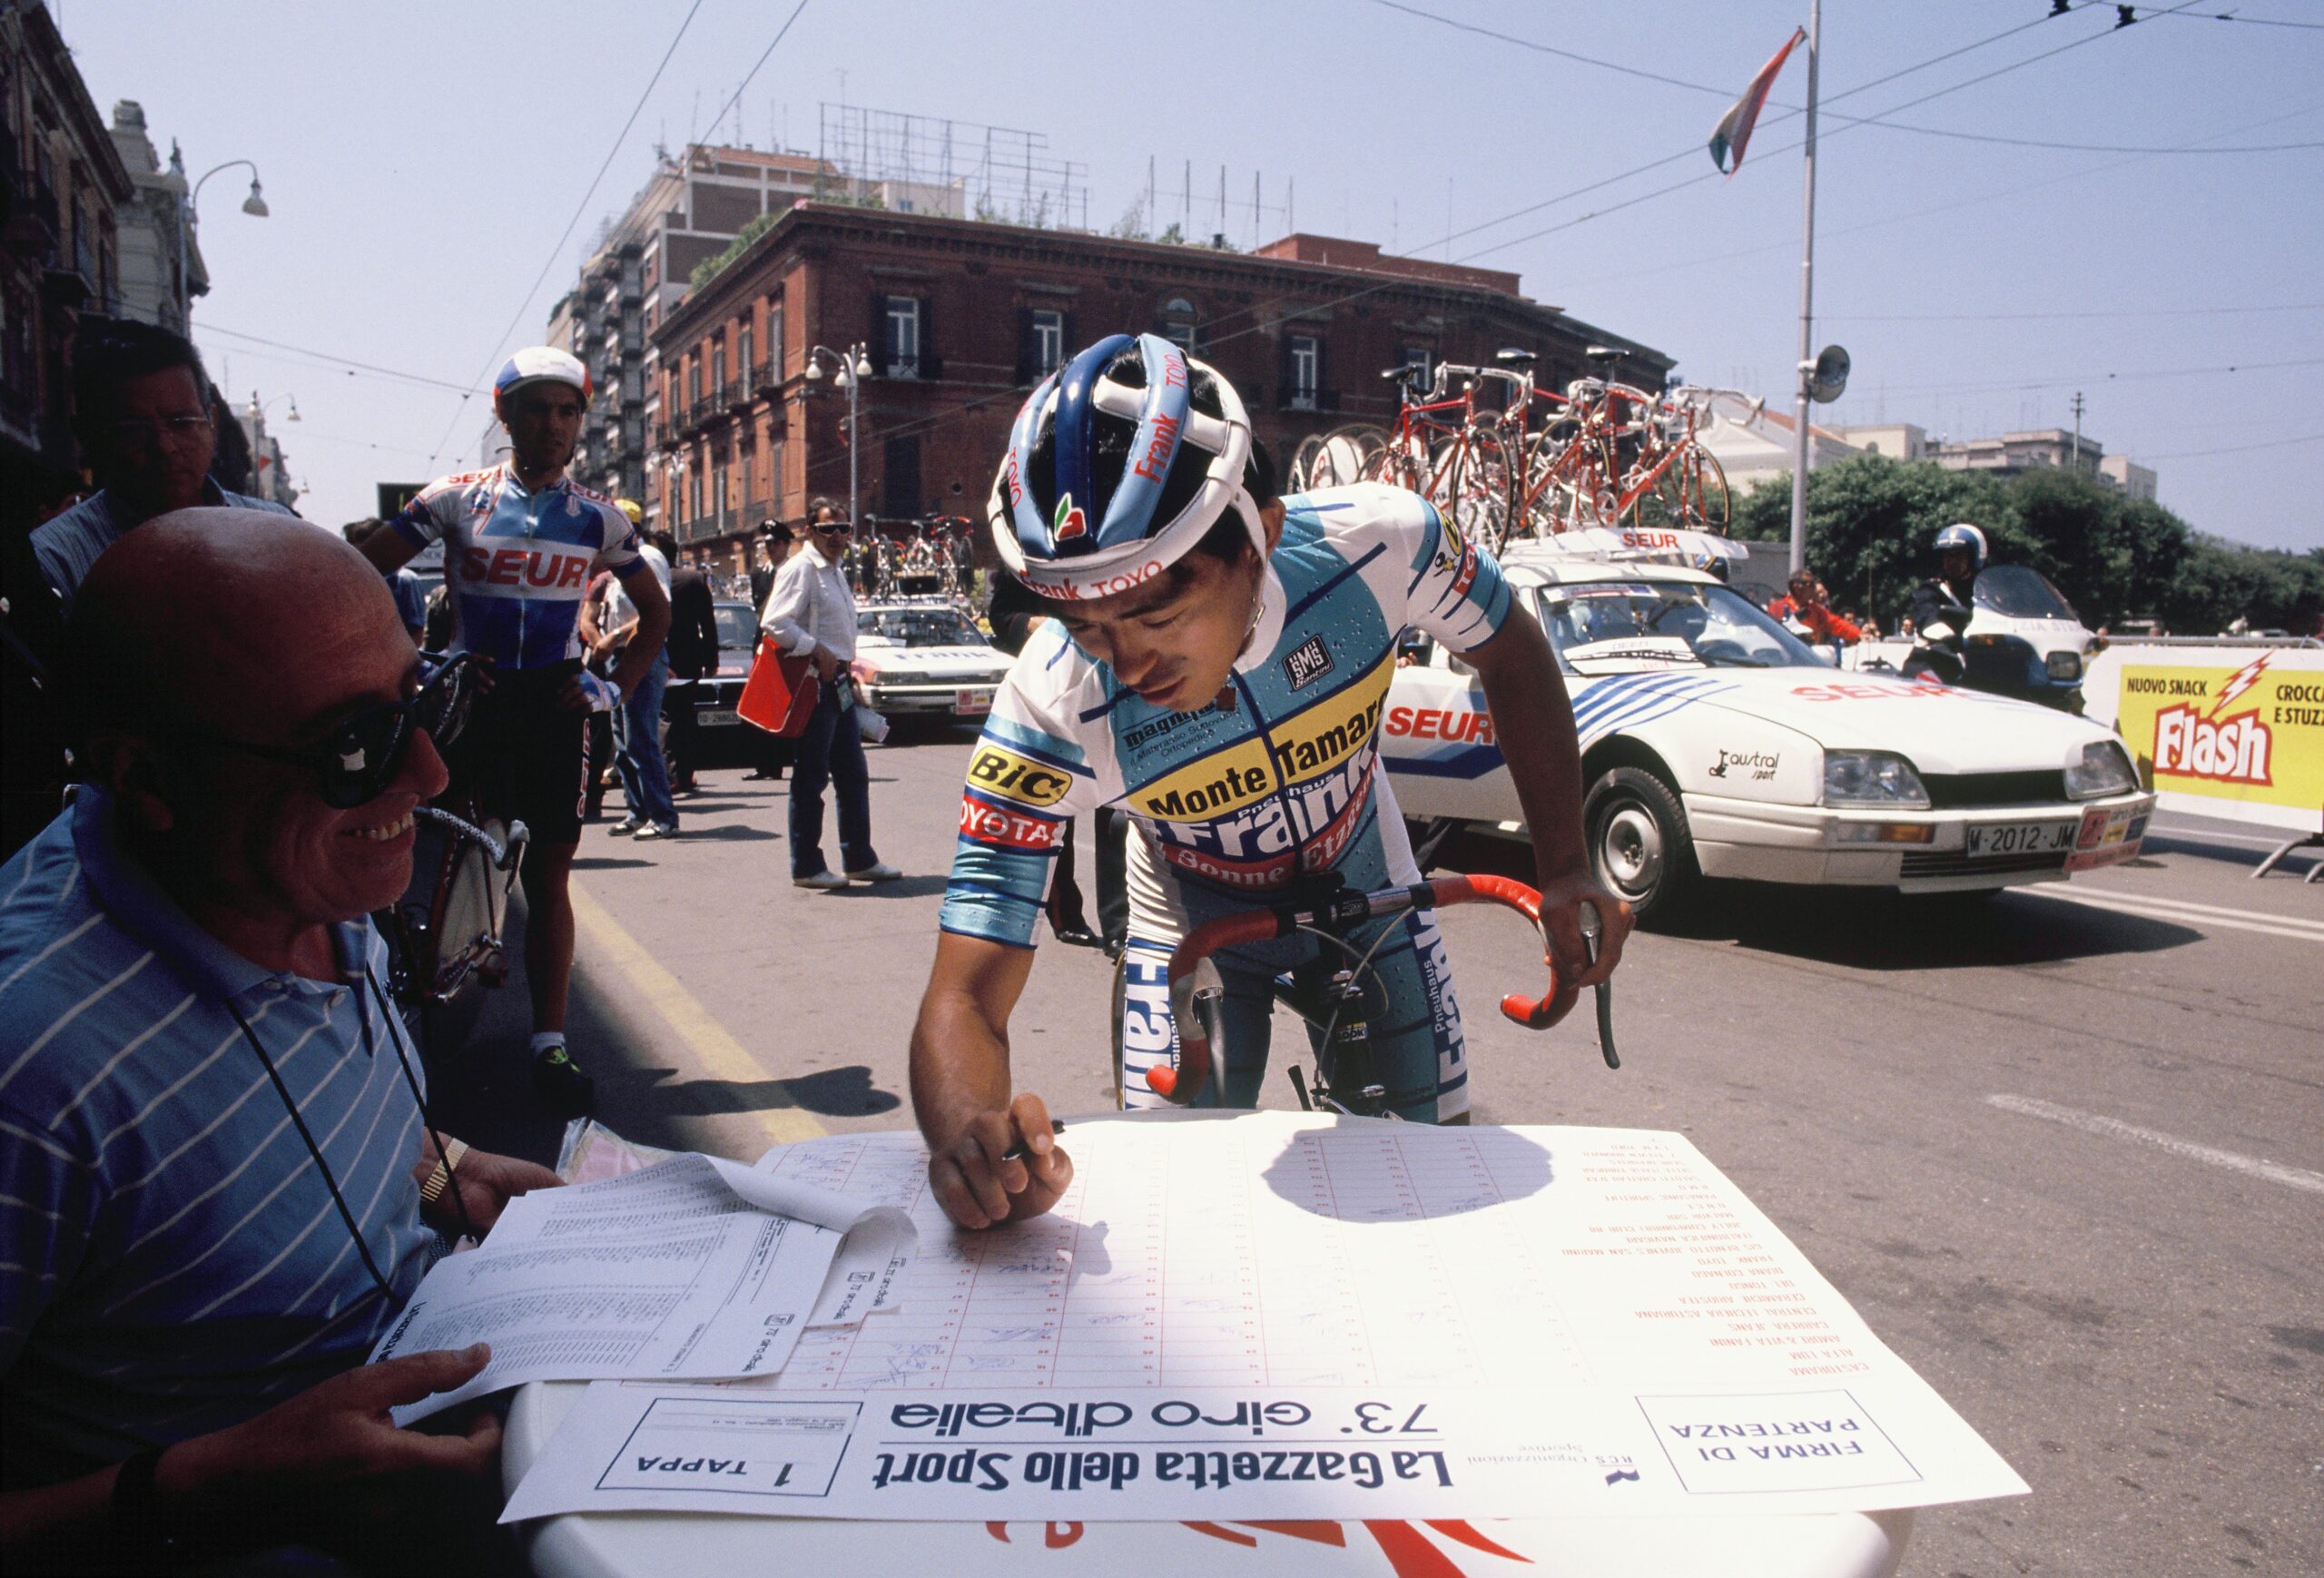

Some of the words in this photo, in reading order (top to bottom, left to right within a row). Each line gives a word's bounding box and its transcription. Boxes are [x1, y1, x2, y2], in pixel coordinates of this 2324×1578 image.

[1135, 414, 1179, 486] Frank
[1621, 531, 1680, 549] SEUR
[460, 547, 589, 588] SEUR
[1090, 559, 1164, 598] TOYO
[2127, 678, 2166, 695] NUOVO
[2169, 683, 2208, 697] SNACK
[1385, 706, 1495, 745] SEUR
[2274, 707, 2282, 724] E
[2155, 708, 2268, 781] Flash
[1730, 753, 1779, 769] austral
[1146, 765, 1269, 817] Monte
[1164, 740, 1375, 859] Frank
[960, 800, 1049, 843] OYOTA
[1177, 847, 1285, 886] Sonne
[1423, 960, 1464, 1033] Pneuhaus
[1735, 1254, 1774, 1265] FRANK
[1634, 1309, 1701, 1320] ASTURIANA
[1727, 1322, 1766, 1333] JEANS
[1772, 1321, 1829, 1331] CARRERA
[1707, 1336, 1752, 1347] FANINI
[1755, 1336, 1784, 1346] VITA
[1787, 1350, 1817, 1361] LUM
[1820, 1348, 1854, 1359] ALFA
[1787, 1361, 1869, 1376] CASTORAMA
[1670, 1418, 1860, 1439] PARTENZA
[1697, 1445, 1737, 1462] DI
[1747, 1440, 1865, 1461] FIRMA
[636, 1456, 748, 1475] TAPPA
[773, 1462, 795, 1487] 1
[872, 1448, 1014, 1491] Sport
[1024, 1450, 1141, 1491] dello
[1155, 1450, 1386, 1491] Gazzetta
[1388, 1450, 1454, 1489] La
